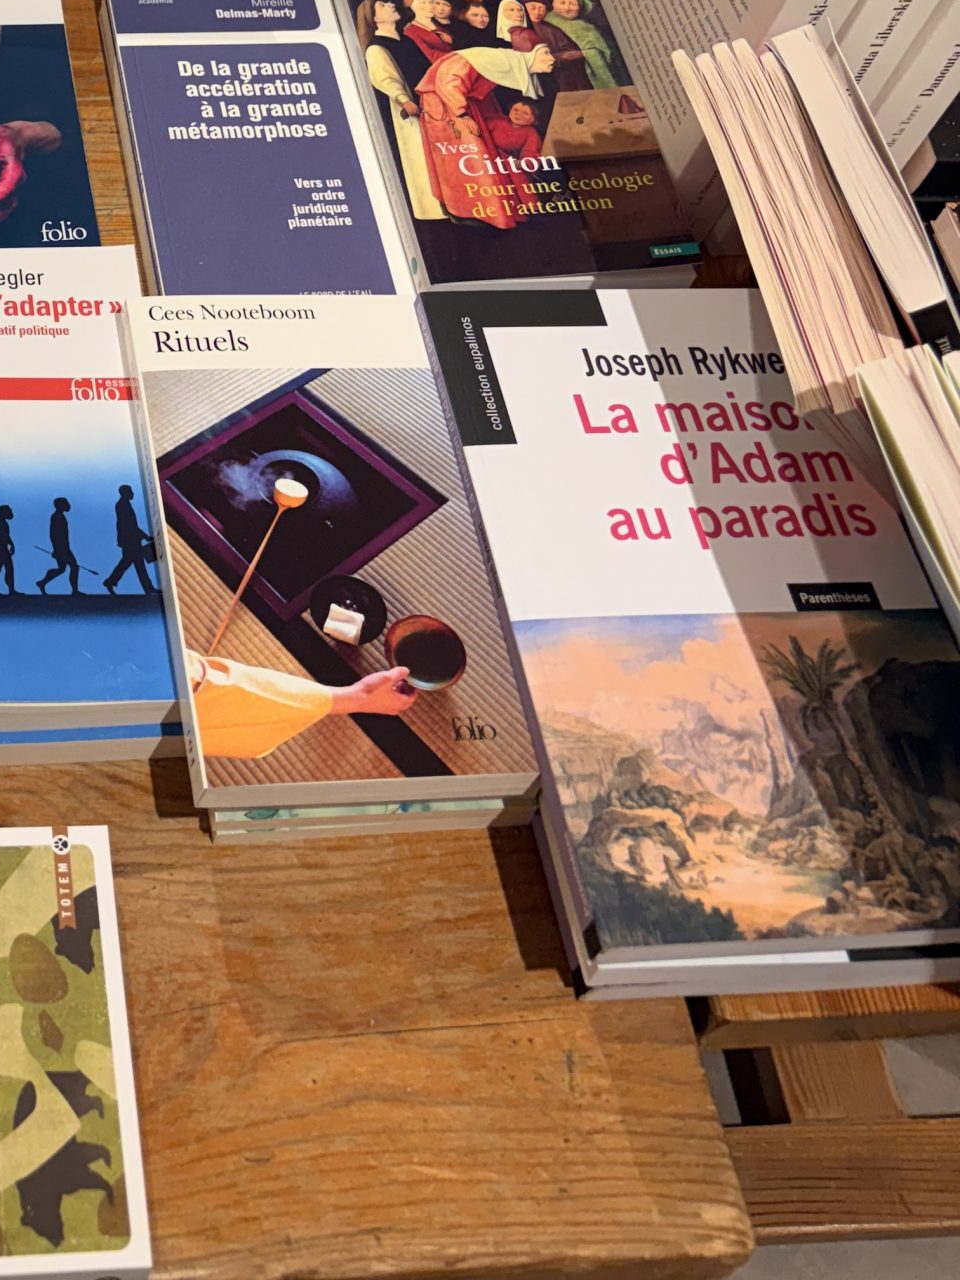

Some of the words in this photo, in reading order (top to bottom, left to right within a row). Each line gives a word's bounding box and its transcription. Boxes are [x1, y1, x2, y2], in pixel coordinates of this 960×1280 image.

[216, 8, 296, 20] Delmas-Marty
[177, 60, 205, 77] De
[238, 59, 311, 81] grande
[185, 80, 317, 98] accélération
[168, 122, 328, 142] métamorphose
[436, 141, 478, 155] Yves
[458, 154, 562, 177] Citton
[294, 178, 323, 189] Vers
[465, 181, 516, 198] Pour
[523, 179, 563, 195] une
[568, 171, 656, 193] écologie
[312, 190, 345, 201] ordre
[504, 195, 615, 215] l'attention
[292, 202, 349, 217] juridique
[40, 220, 87, 242] folio
[288, 215, 353, 230] planétaire
[148, 305, 195, 322] Cees
[199, 304, 316, 320] Nooteboom
[19, 325, 70, 338] politique
[153, 329, 249, 354] Rituels
[461, 316, 485, 371] eupalinos
[581, 346, 683, 382] Joseph
[70, 377, 120, 401] folio
[479, 374, 503, 431] collection
[659, 441, 854, 486] d'Adam
[606, 505, 672, 541] au
[688, 496, 877, 550] paradis
[799, 589, 872, 606] Parenthèses
[57, 862, 72, 918] TOTEM
